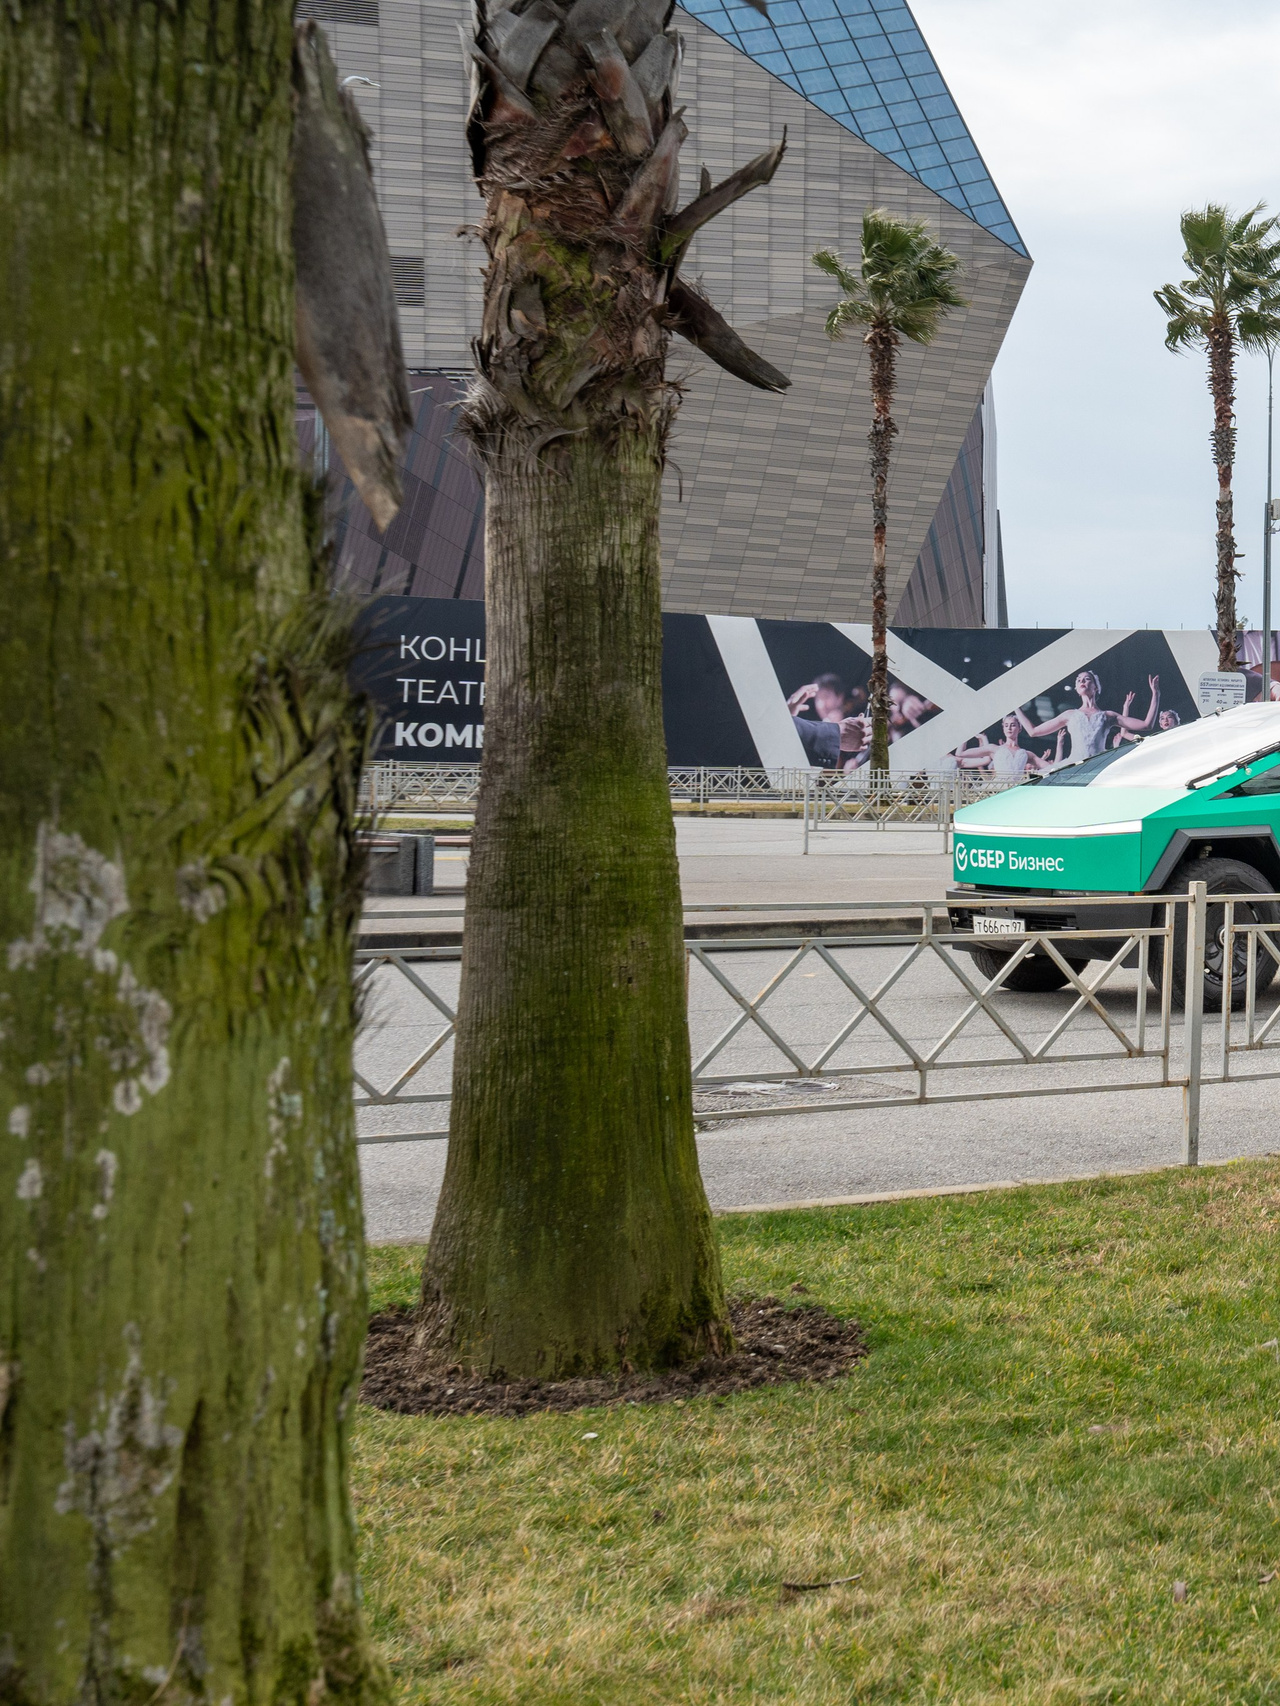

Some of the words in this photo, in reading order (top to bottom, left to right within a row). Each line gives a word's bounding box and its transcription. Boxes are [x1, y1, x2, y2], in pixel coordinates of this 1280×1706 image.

[396, 678, 486, 706] ТЕАТ
[969, 848, 1005, 869] СБЕР
[1008, 851, 1065, 872] Бизнес
